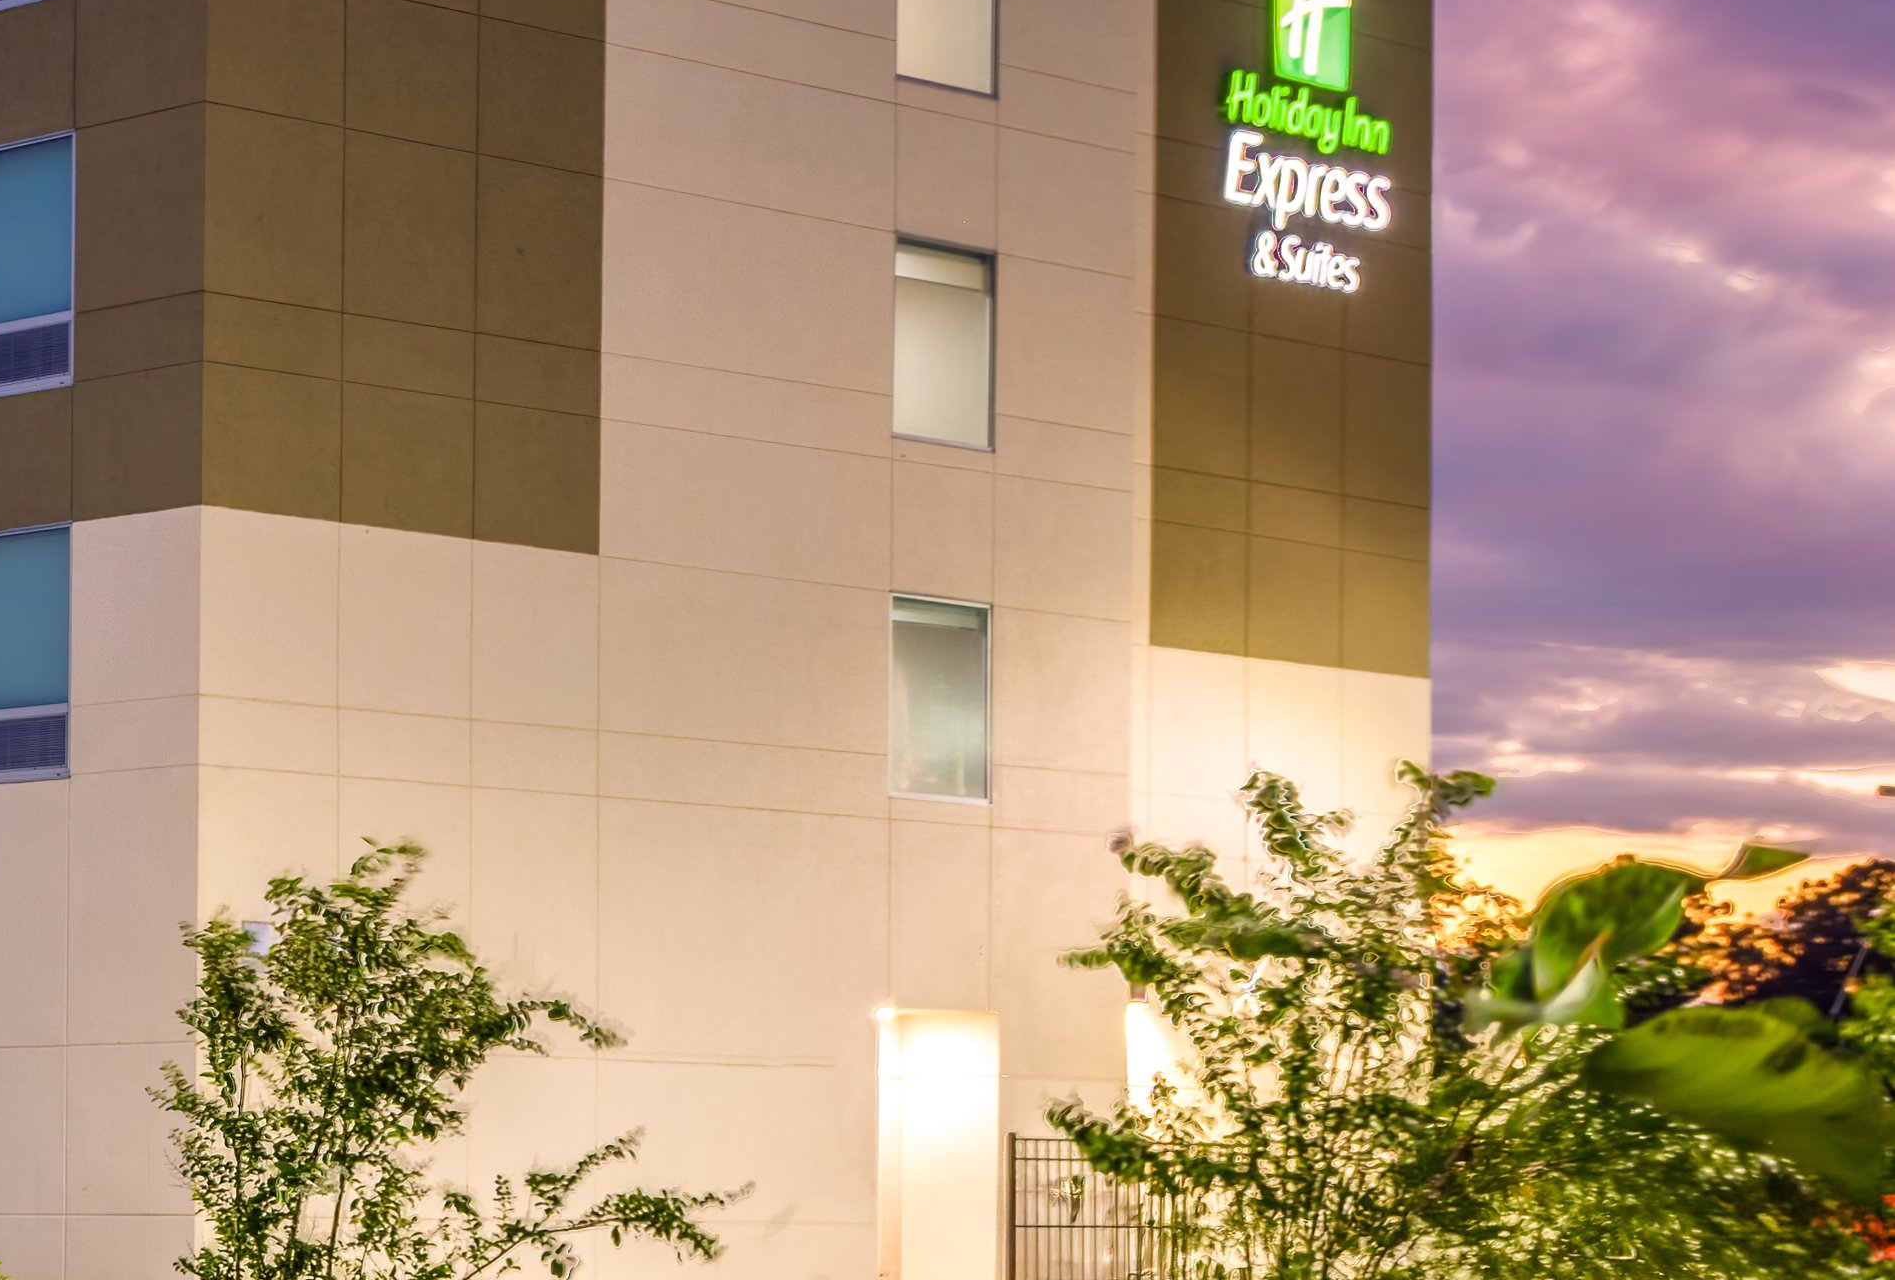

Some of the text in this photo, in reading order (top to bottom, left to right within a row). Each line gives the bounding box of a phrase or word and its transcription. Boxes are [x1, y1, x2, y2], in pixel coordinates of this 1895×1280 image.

[1226, 70, 1393, 154] Holiday Inn
[1225, 130, 1393, 230] Express
[1252, 231, 1361, 293] & Suites
